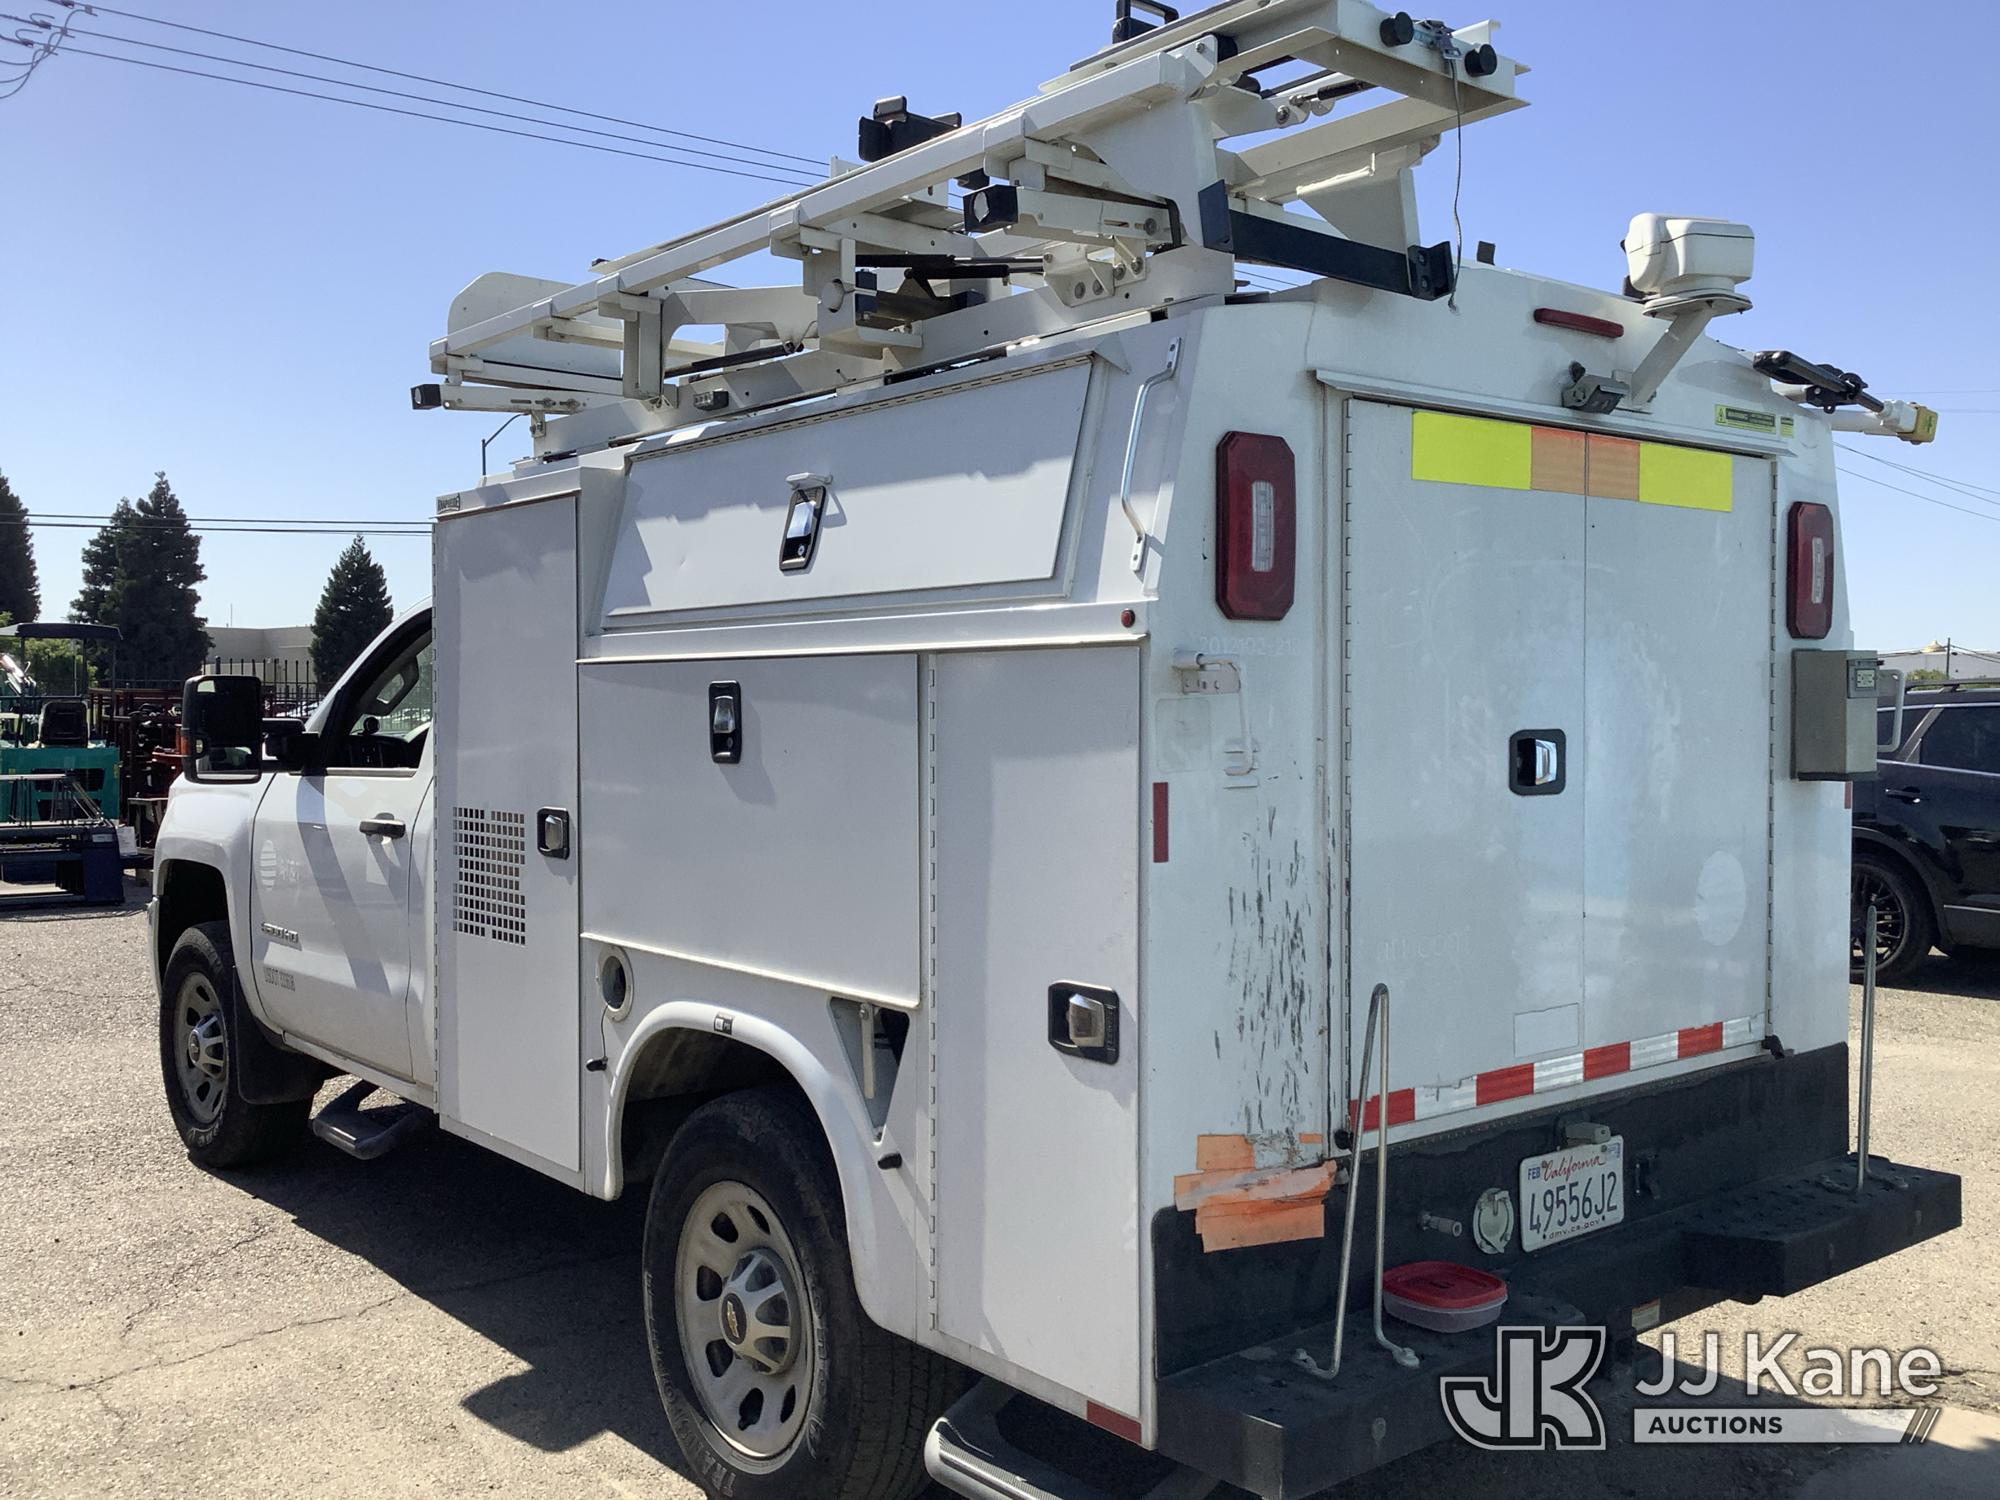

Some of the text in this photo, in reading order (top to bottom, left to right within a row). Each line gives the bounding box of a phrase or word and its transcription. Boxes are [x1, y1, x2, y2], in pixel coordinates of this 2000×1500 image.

[1528, 1166, 1540, 1180] FEB
[1542, 1156, 1606, 1181] California
[1529, 1171, 1617, 1235] 49556J2
[1549, 1220, 1600, 1239] dmv.ca.gov
